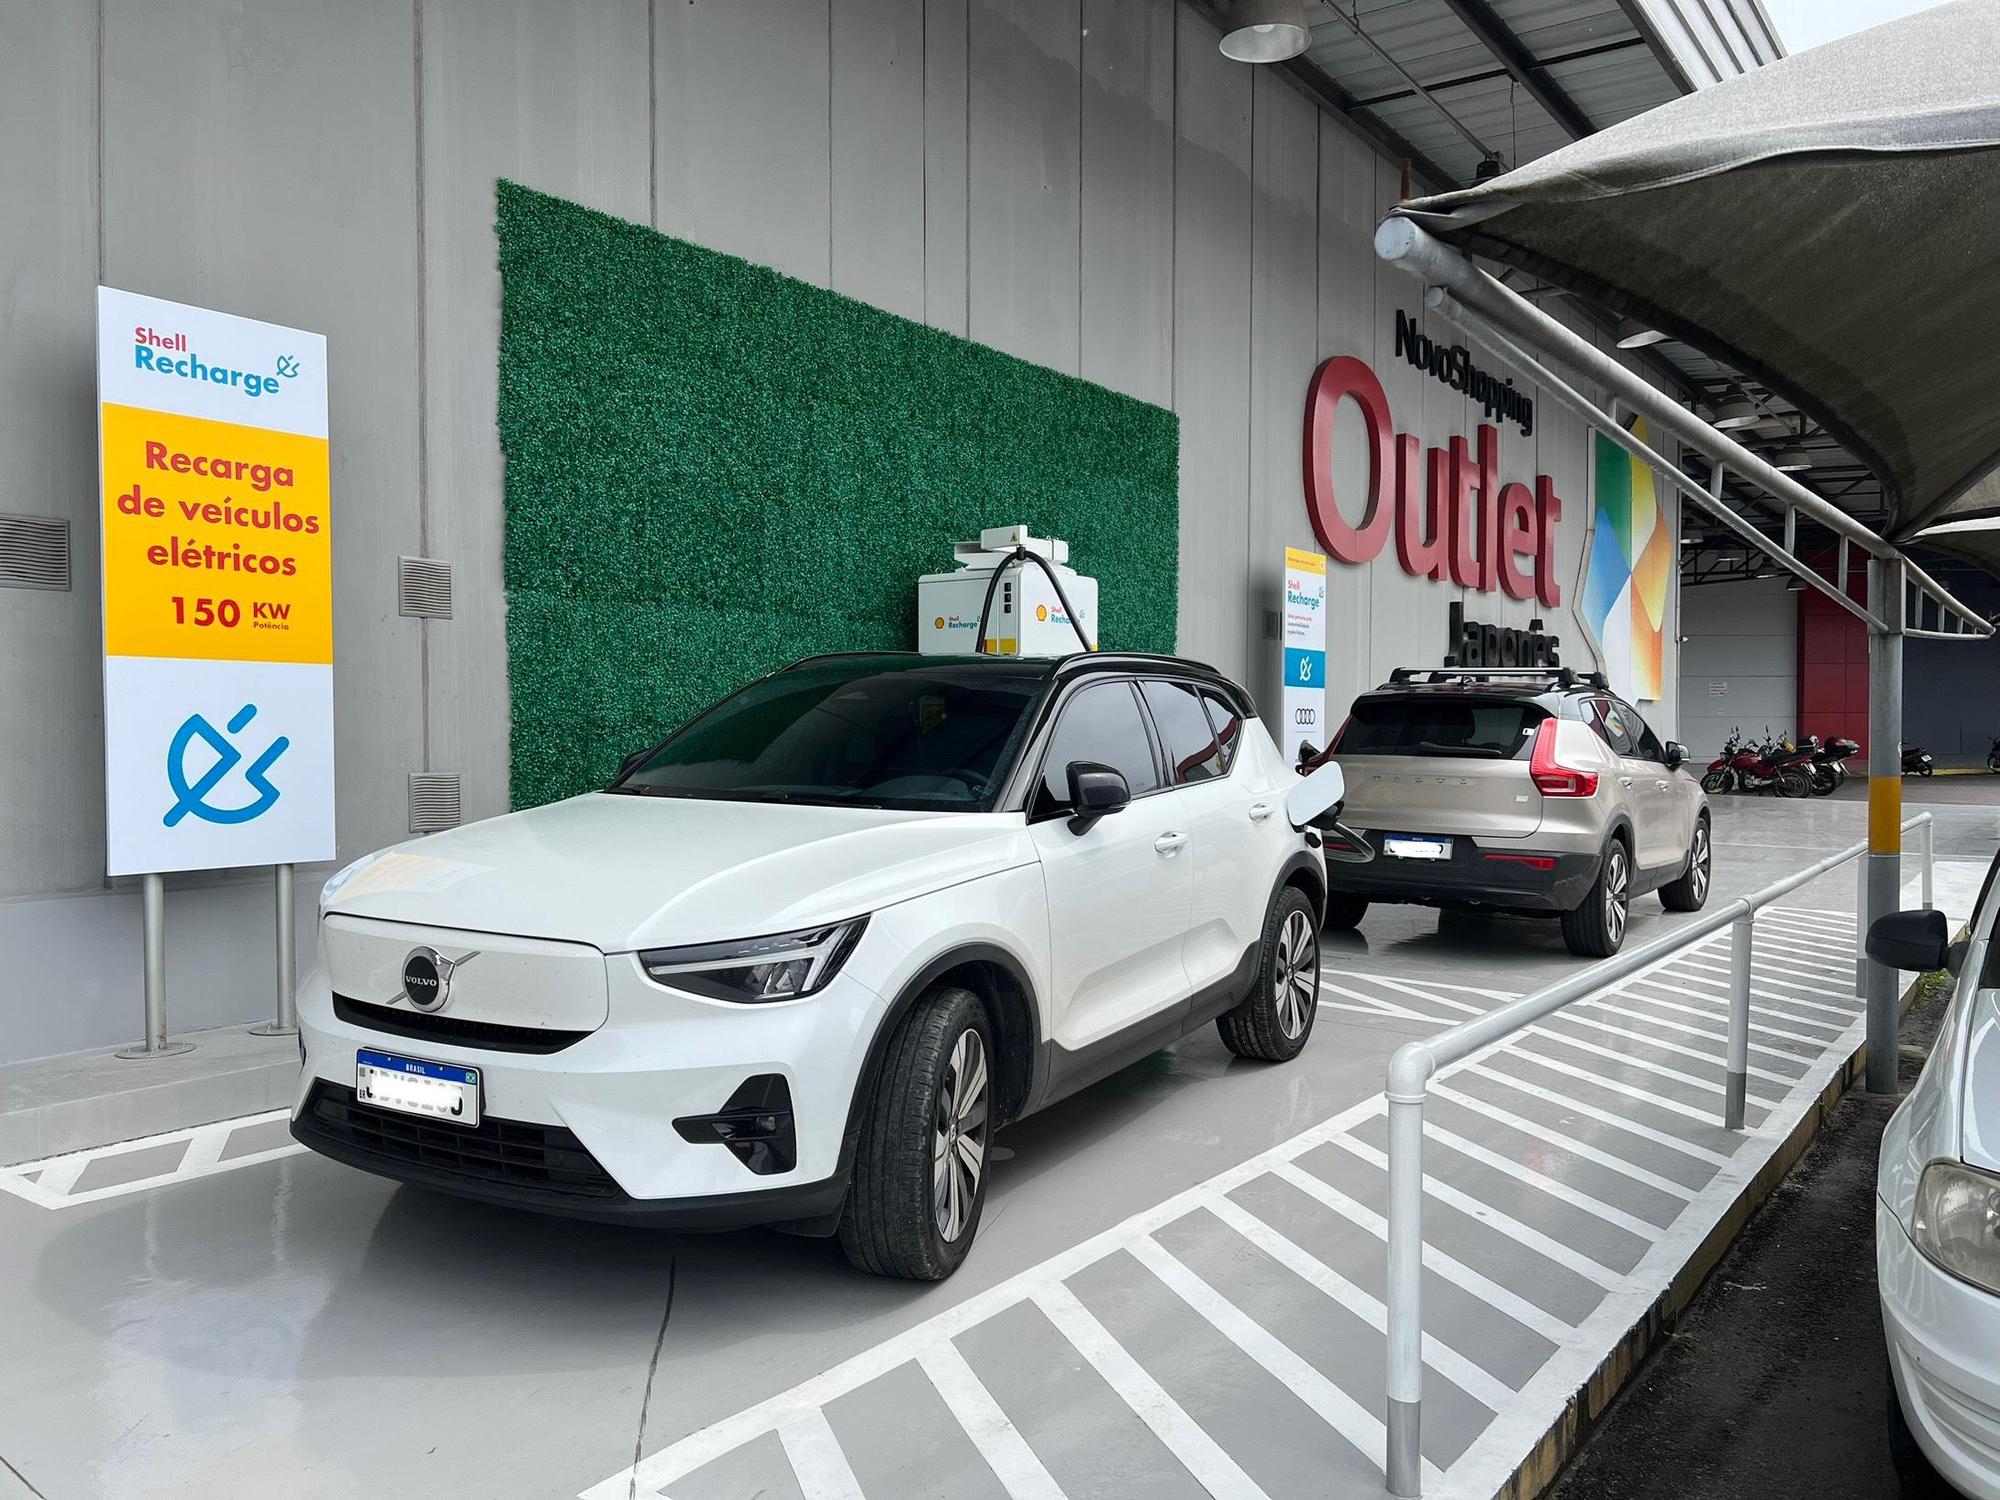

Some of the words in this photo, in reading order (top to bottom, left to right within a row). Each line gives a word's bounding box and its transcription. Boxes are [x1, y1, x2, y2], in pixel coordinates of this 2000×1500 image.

[134, 326, 186, 352] Shell
[135, 344, 280, 397] Recharge
[1395, 309, 1533, 437] NovoShopping
[145, 440, 294, 492] Recarga
[1303, 355, 1562, 608] Outlet
[117, 484, 166, 517] de
[178, 496, 320, 534] veículos
[147, 536, 297, 576] elétricos
[1287, 580, 1299, 590] Shell
[1287, 590, 1319, 610] Recharge
[171, 596, 241, 628] 150
[253, 602, 291, 620] KW
[253, 621, 289, 631] Potência
[949, 621, 978, 630] Recharge
[1444, 601, 1560, 668] Japonês
[405, 975, 437, 986] VOLVO
[405, 1063, 426, 1075] BRASIL
